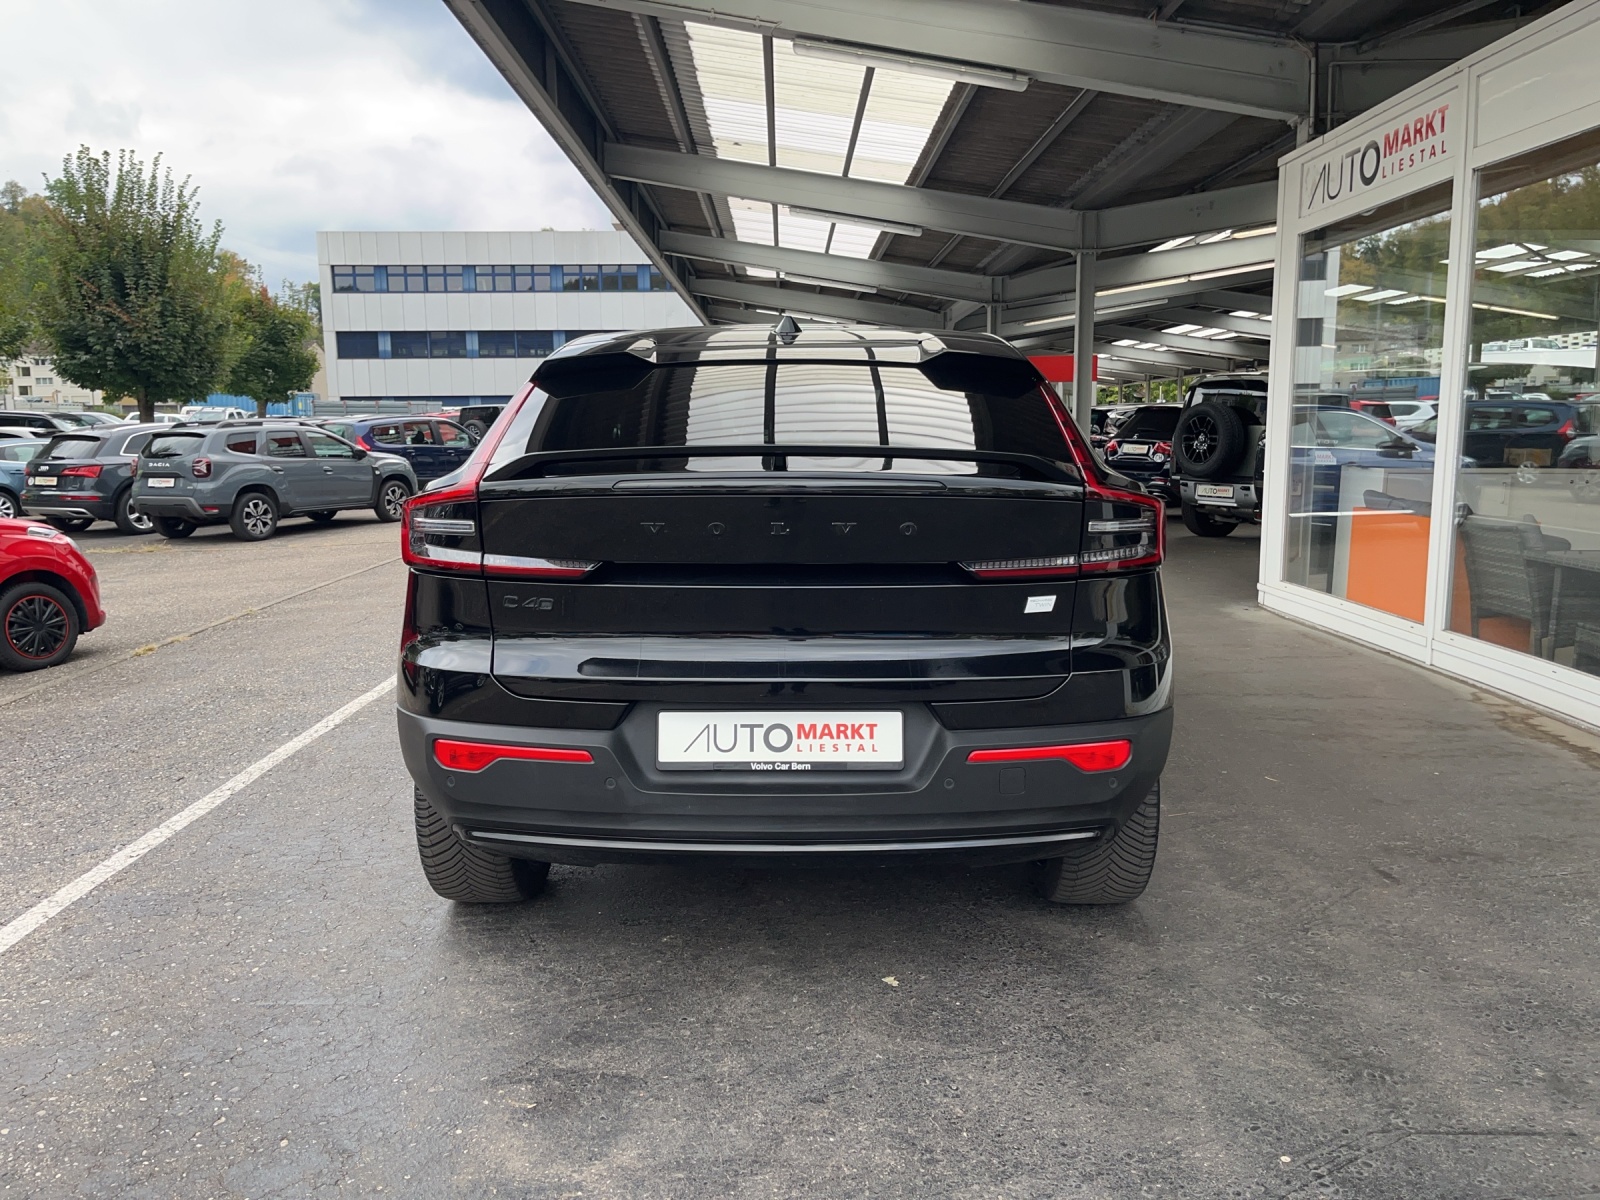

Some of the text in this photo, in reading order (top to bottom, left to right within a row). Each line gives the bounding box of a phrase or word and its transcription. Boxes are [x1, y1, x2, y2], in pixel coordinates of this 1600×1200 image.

[1307, 103, 1450, 210] AUTO MARKT
[1381, 139, 1448, 180] LIESTAL
[639, 521, 918, 536] VOLVO
[683, 722, 878, 754] AUTO MARKT
[796, 743, 878, 753] LIESTAL
[750, 762, 811, 771] Volvo Car Bern
